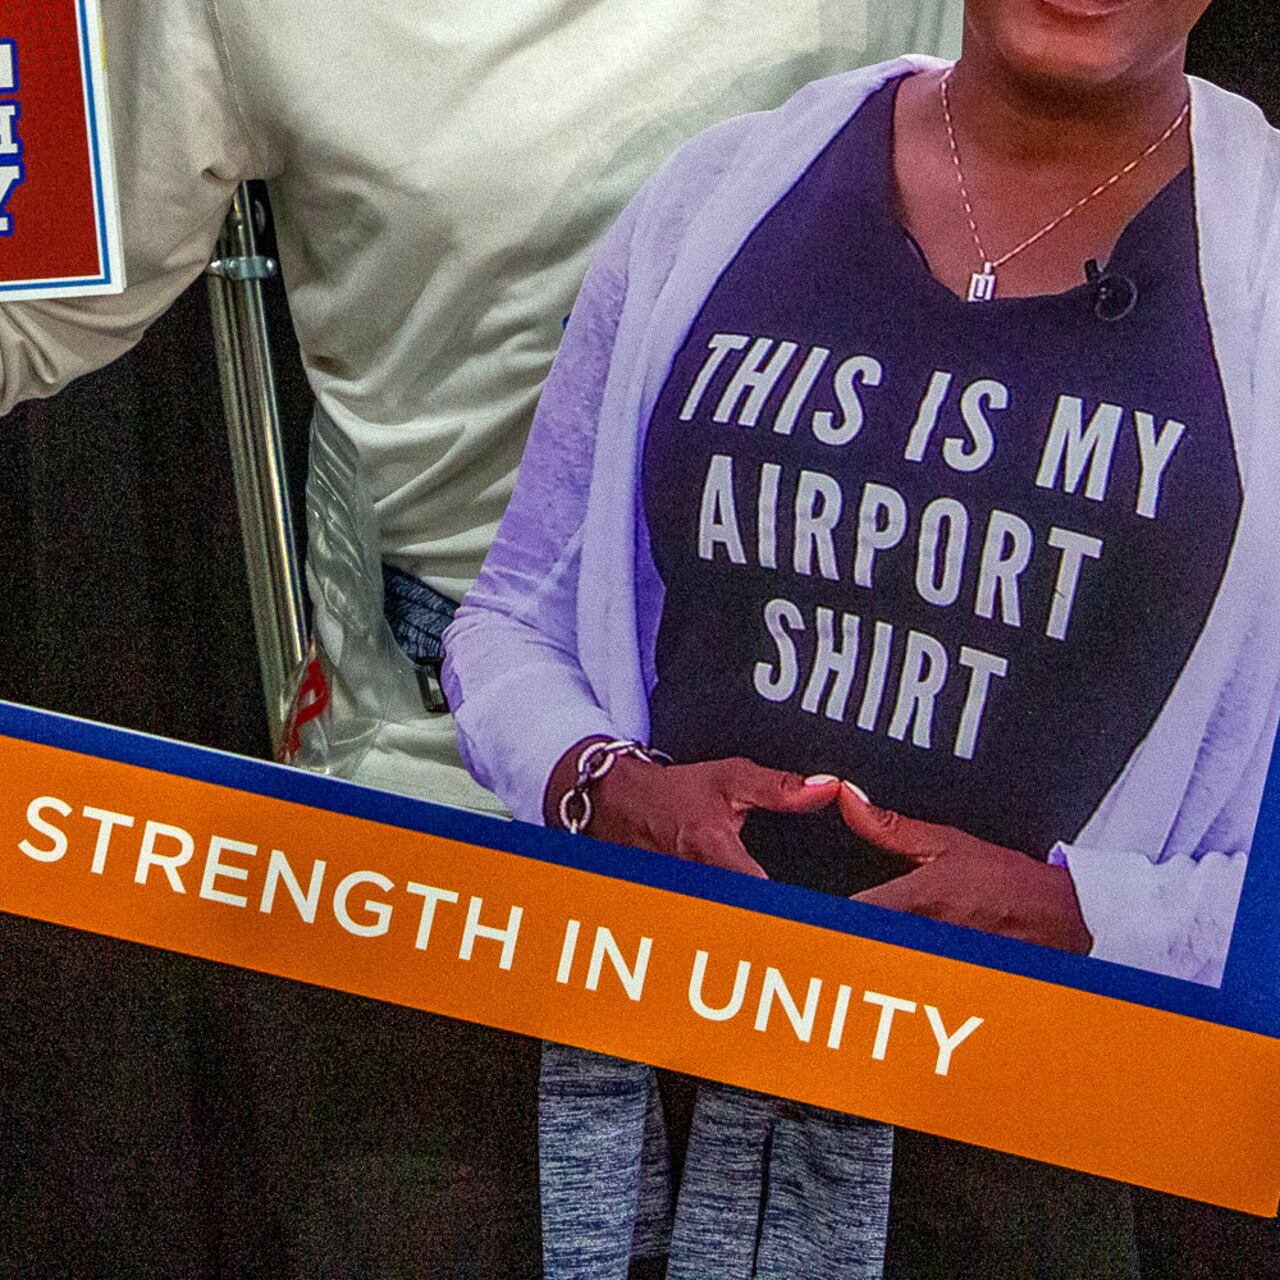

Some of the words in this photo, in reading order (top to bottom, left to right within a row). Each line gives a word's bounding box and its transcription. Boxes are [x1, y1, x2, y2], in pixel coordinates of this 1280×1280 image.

[680, 333, 883, 446] THIS
[905, 371, 1008, 473] IS
[1035, 396, 1186, 519] MY
[697, 454, 1103, 641] AIRPORT
[753, 598, 1009, 760] SHIRT
[17, 795, 524, 971] STRENGTH
[555, 919, 654, 1003] IN
[687, 949, 985, 1077] UNITY
